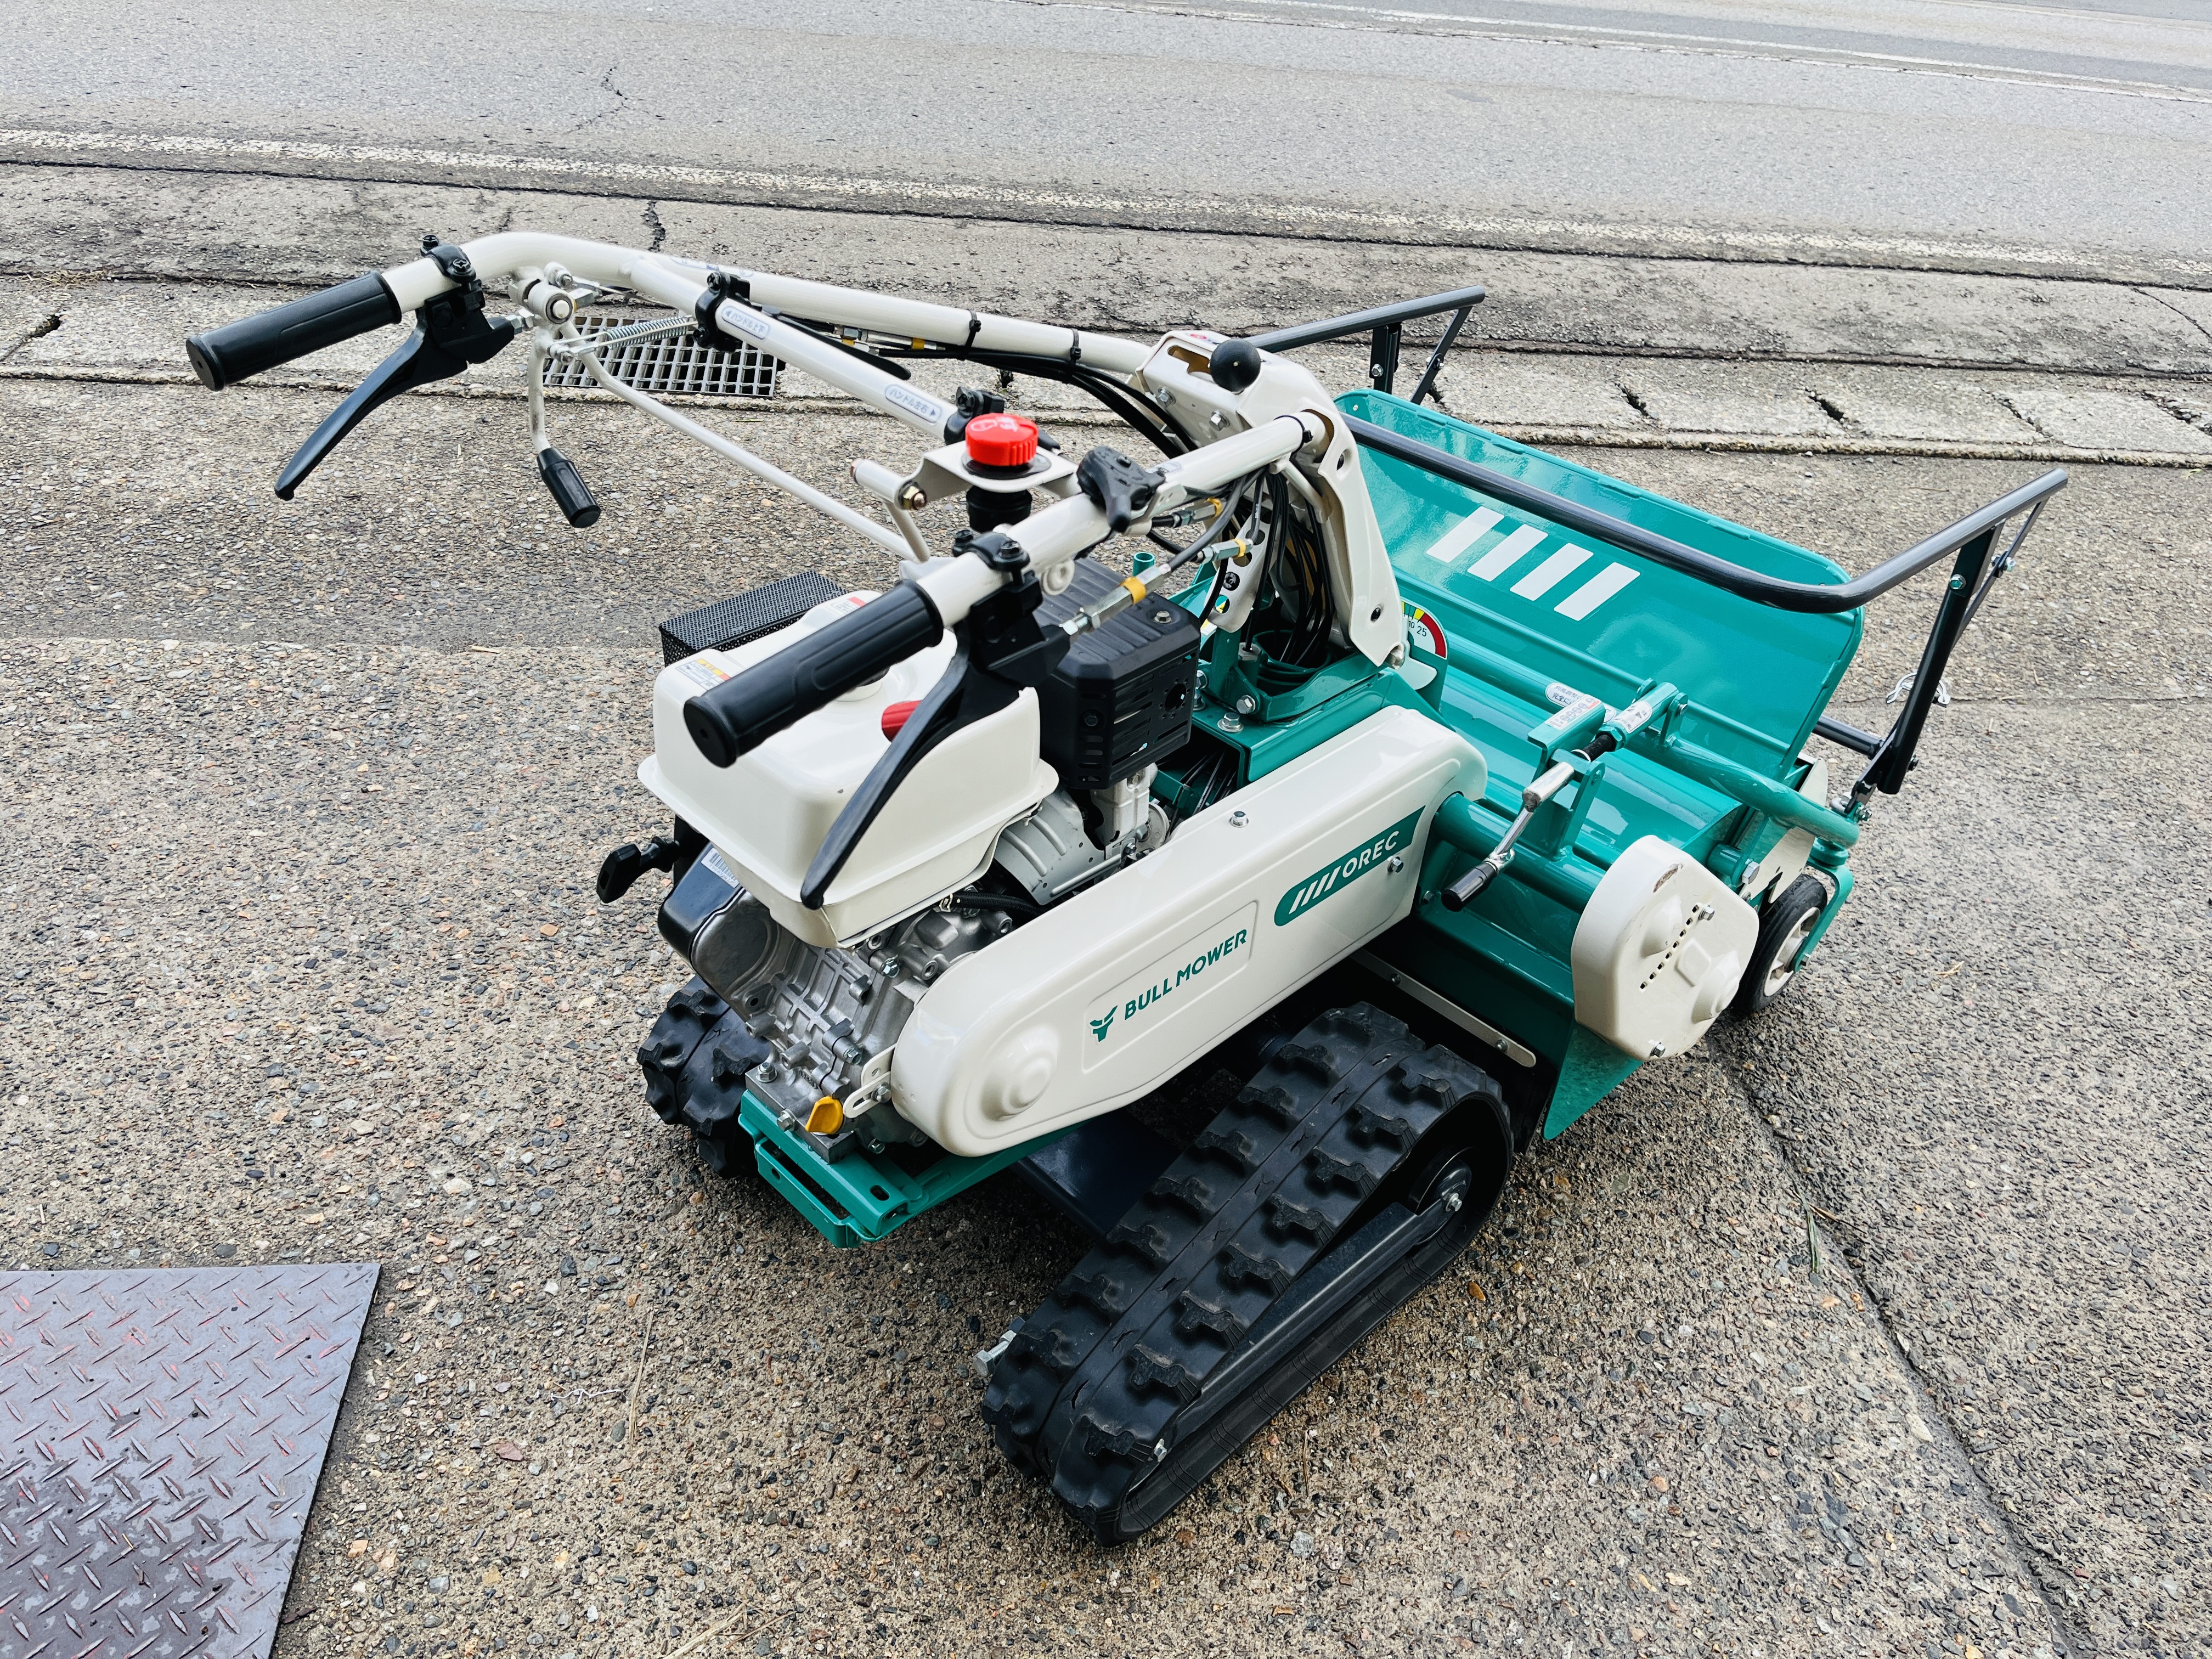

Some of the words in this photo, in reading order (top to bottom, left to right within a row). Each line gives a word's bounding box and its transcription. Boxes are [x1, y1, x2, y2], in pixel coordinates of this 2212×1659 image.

[890, 388, 929, 414] ハンドル左右
[1408, 620, 1415, 629] 10
[1417, 625, 1427, 637] 25
[1342, 831, 1400, 878] OREC
[1125, 978, 1172, 1020] BULL
[1176, 929, 1247, 988] MOWER
